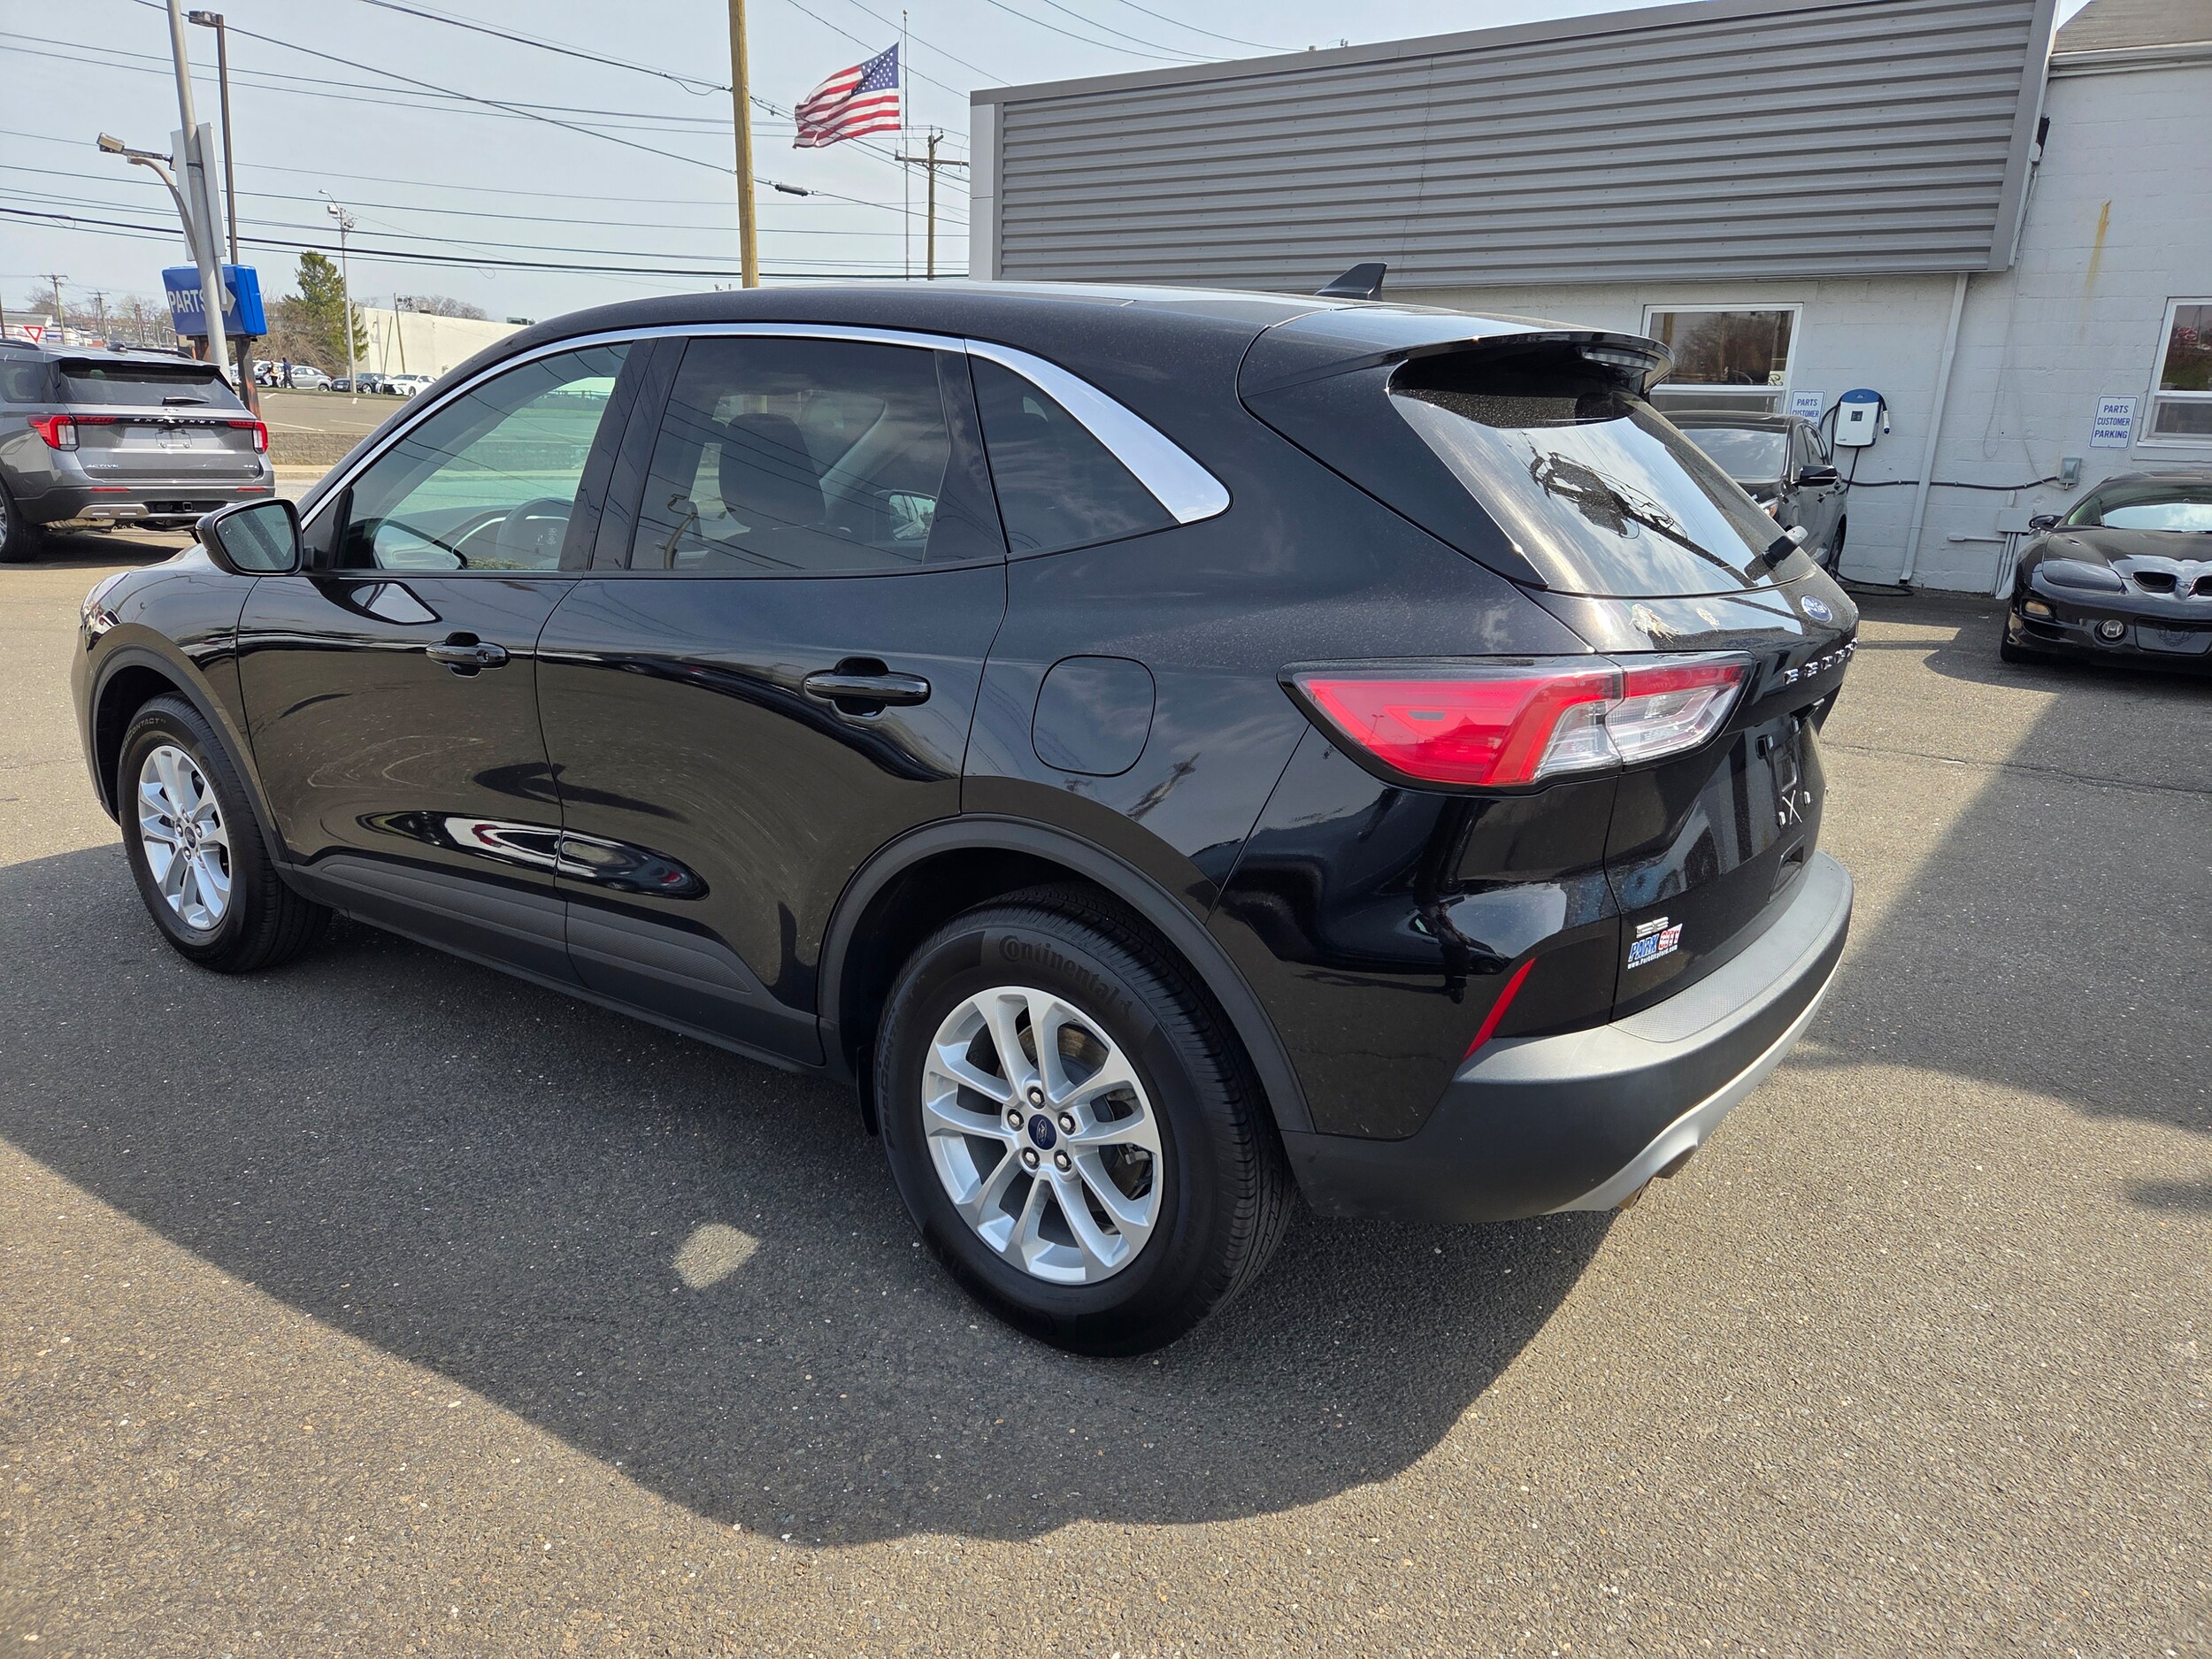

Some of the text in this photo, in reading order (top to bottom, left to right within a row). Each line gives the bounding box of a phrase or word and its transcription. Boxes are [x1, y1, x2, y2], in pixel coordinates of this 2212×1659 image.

[1796, 398, 1818, 407] PARTS
[2103, 404, 2129, 413] PARTS
[2097, 417, 2131, 426] CUSTOMER
[2094, 430, 2128, 439] PARKING
[1636, 917, 1669, 939] SE
[1628, 933, 1660, 963] PARK
[998, 934, 1121, 1005] Continental
